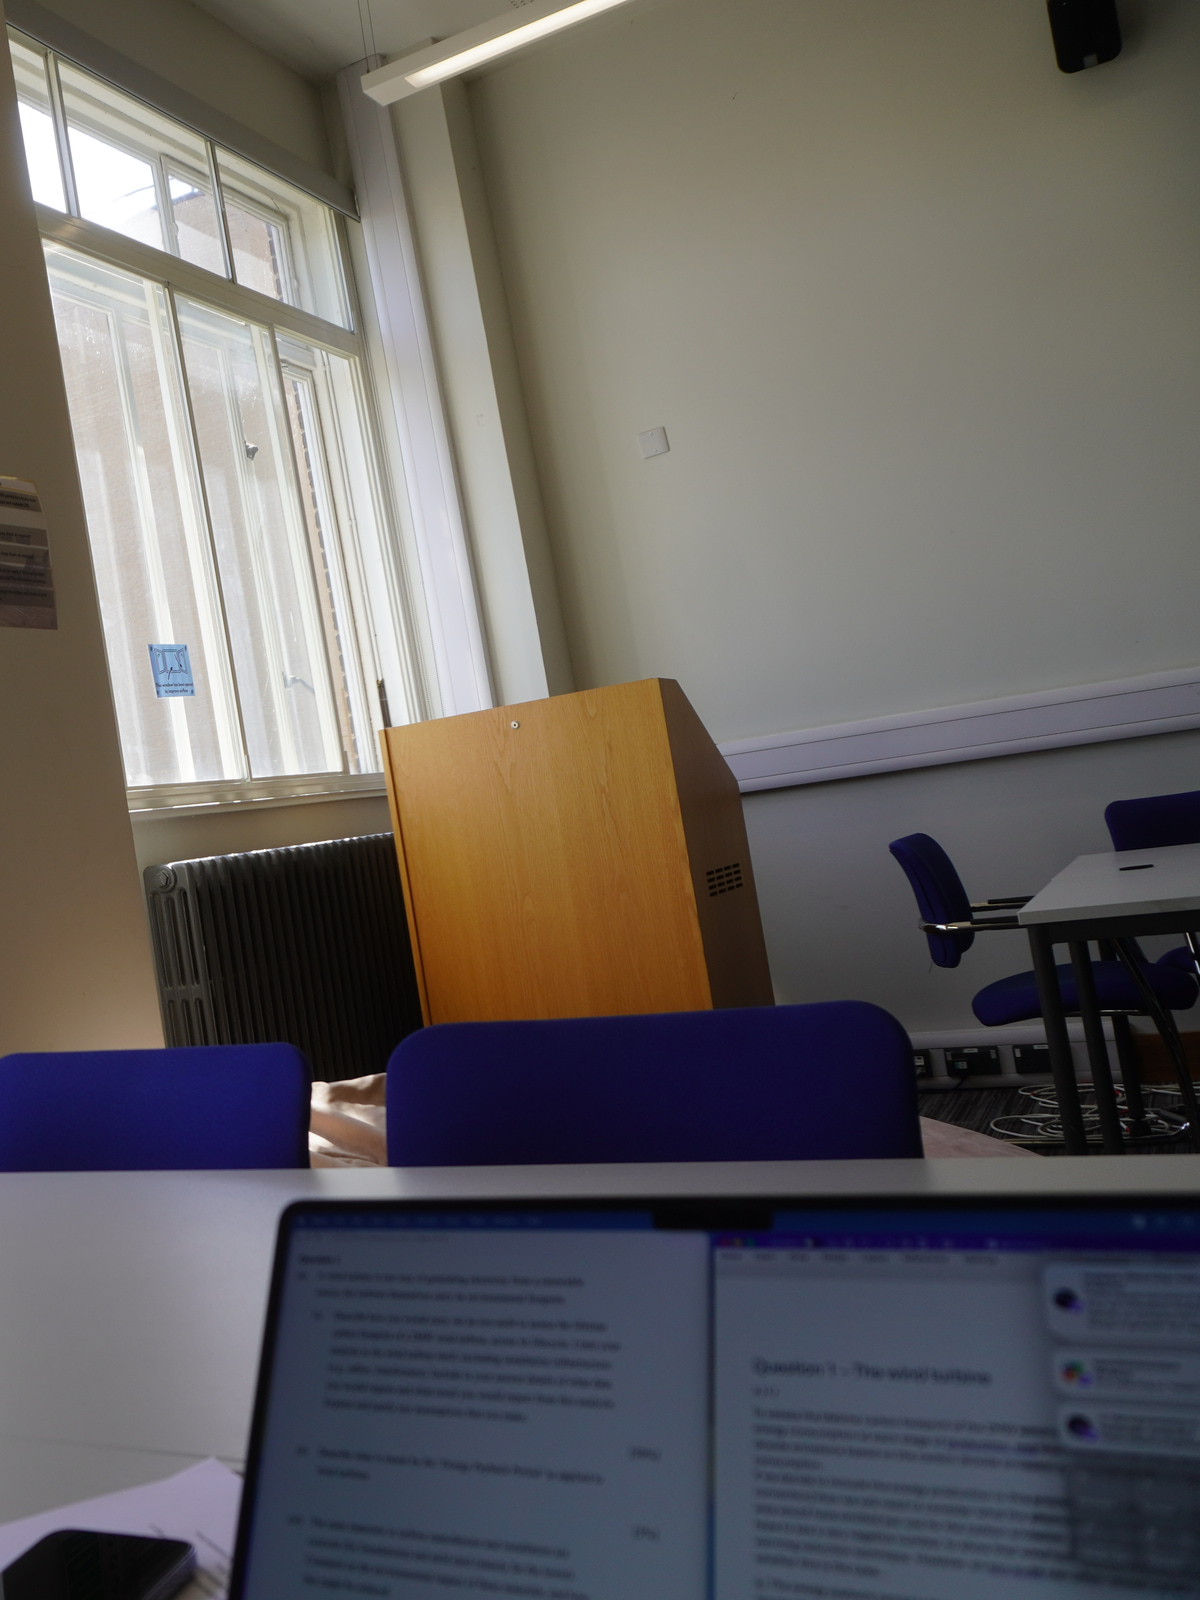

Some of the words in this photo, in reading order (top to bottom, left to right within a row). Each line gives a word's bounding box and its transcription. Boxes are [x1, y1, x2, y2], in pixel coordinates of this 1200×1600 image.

[754, 1358, 825, 1378] Question
[853, 1361, 884, 1380] The
[886, 1365, 928, 1383] wind
[929, 1366, 992, 1387] turbine
